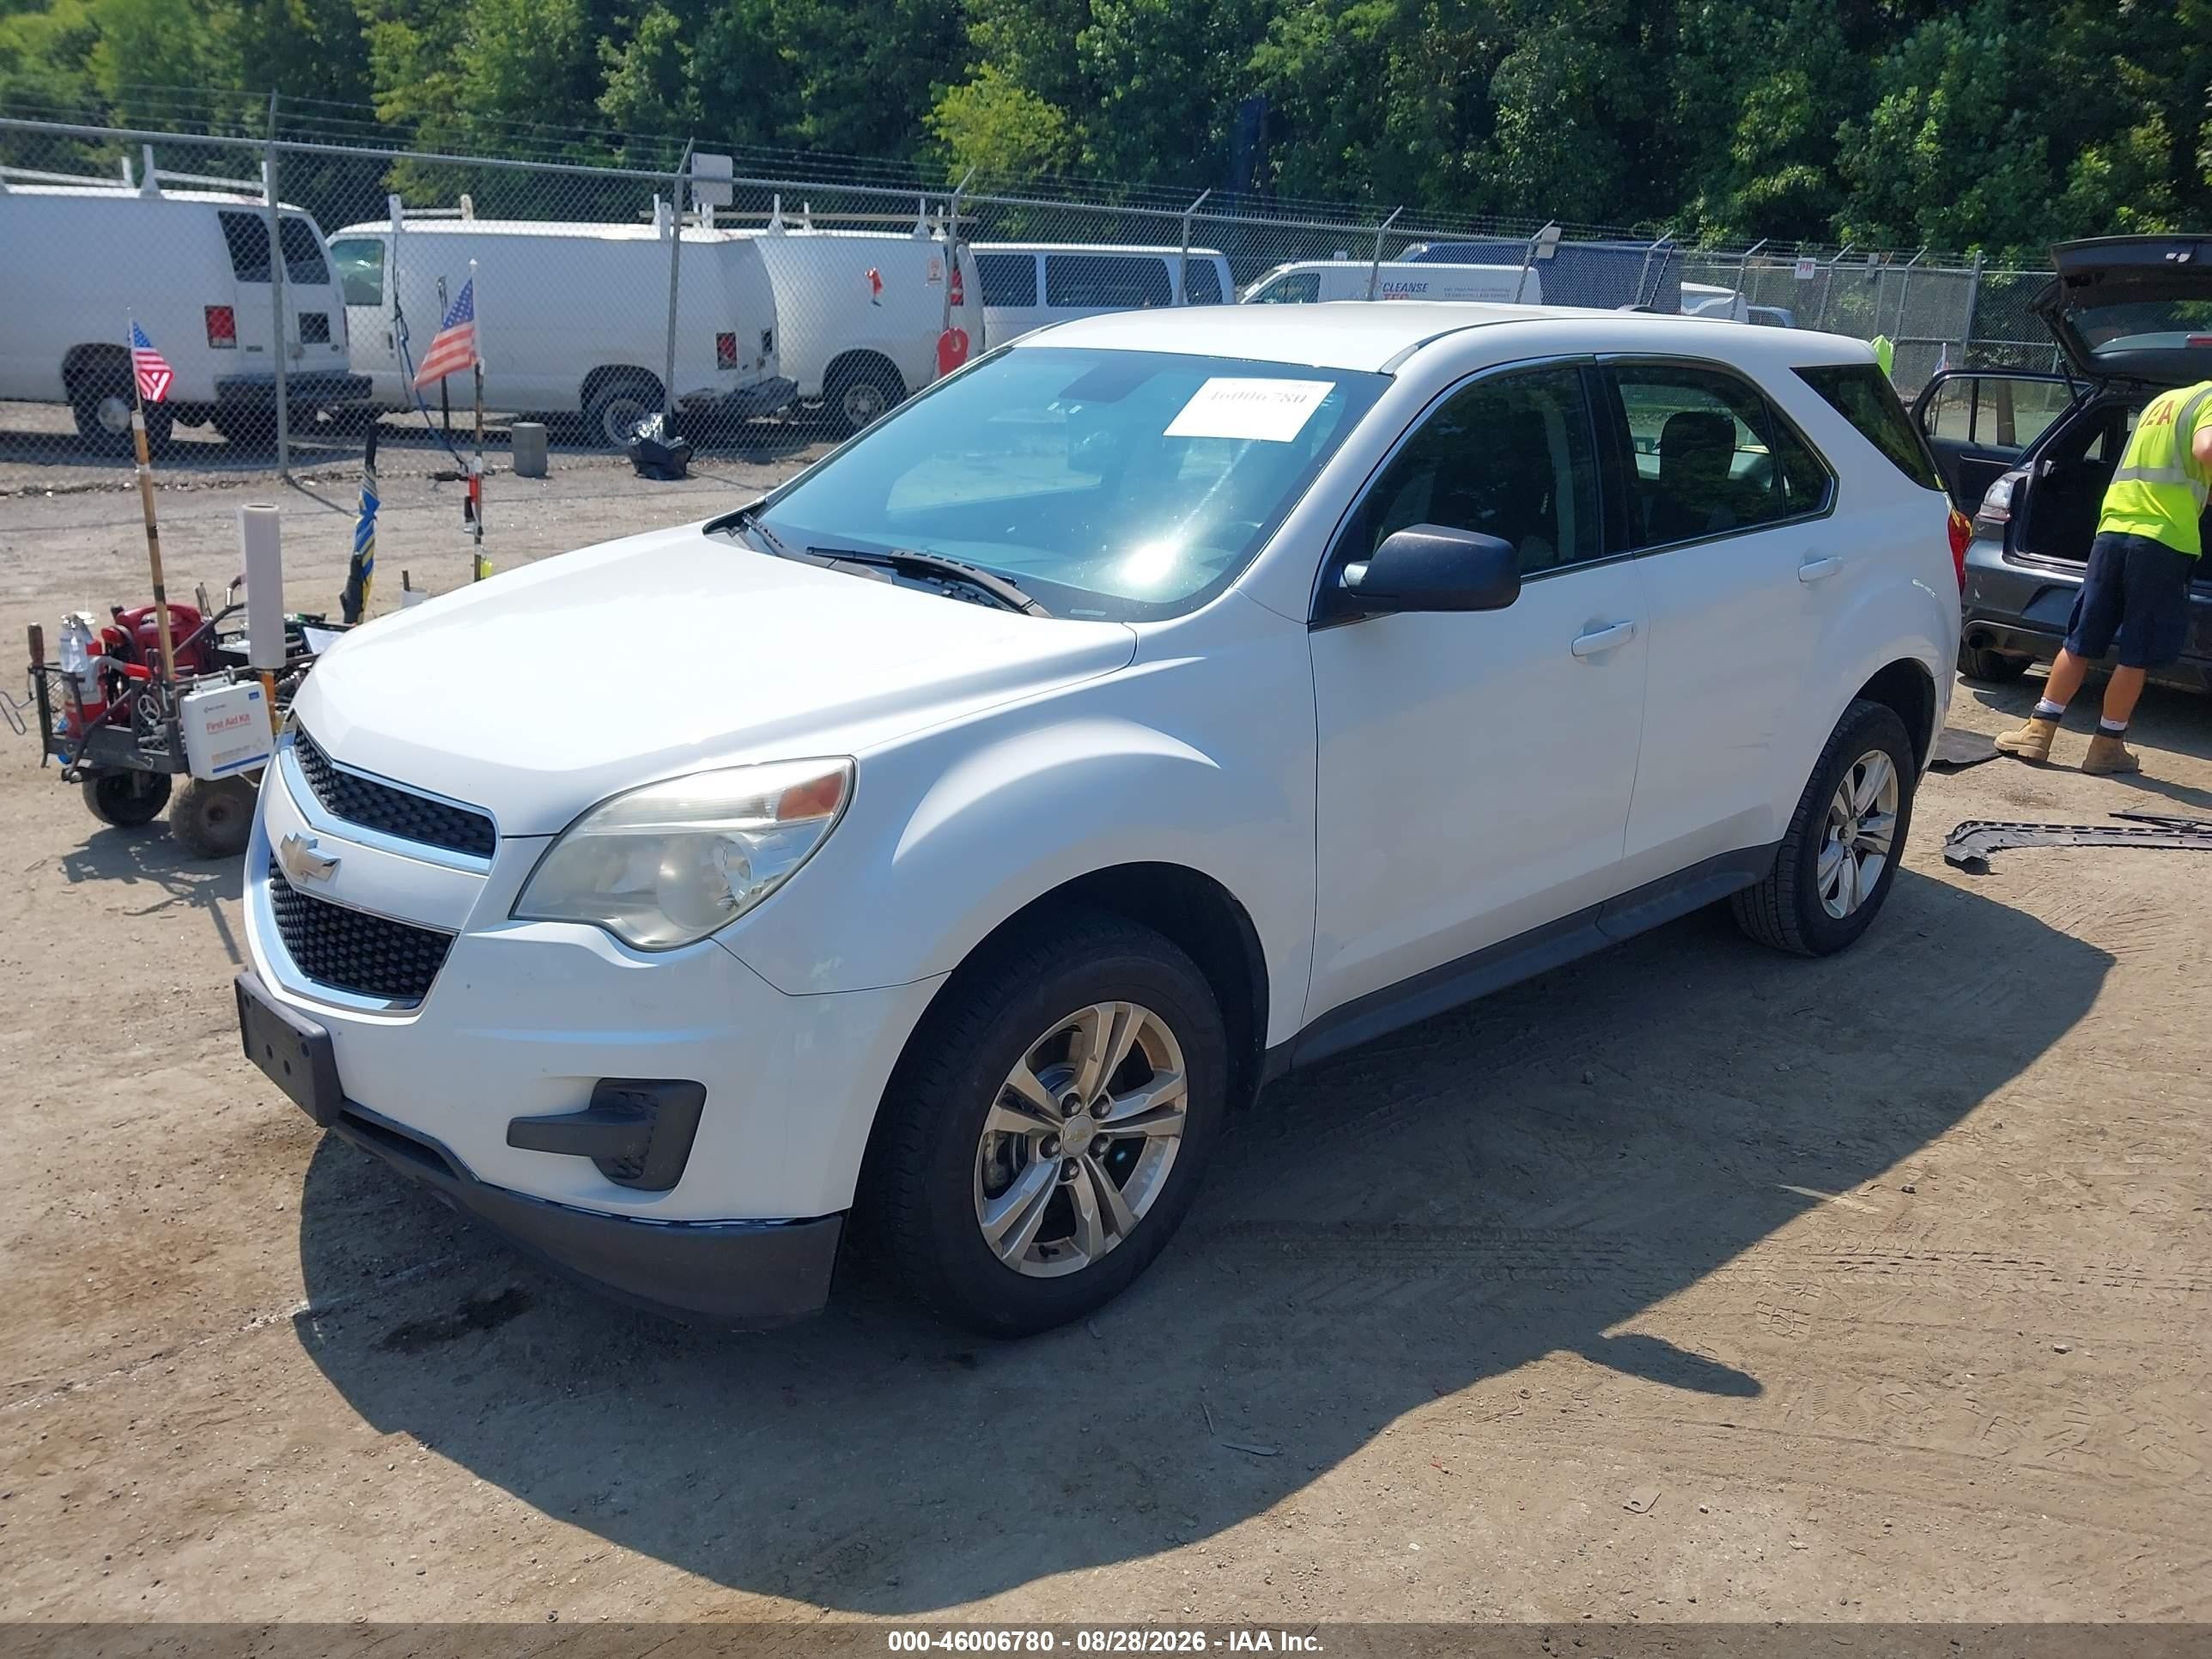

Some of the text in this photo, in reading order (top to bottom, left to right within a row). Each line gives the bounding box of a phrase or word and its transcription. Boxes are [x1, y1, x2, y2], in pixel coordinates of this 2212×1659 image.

[1382, 283, 1429, 293] CLEANSE
[206, 720, 224, 731] First
[225, 715, 239, 726] Aid
[239, 714, 251, 723] Kit
